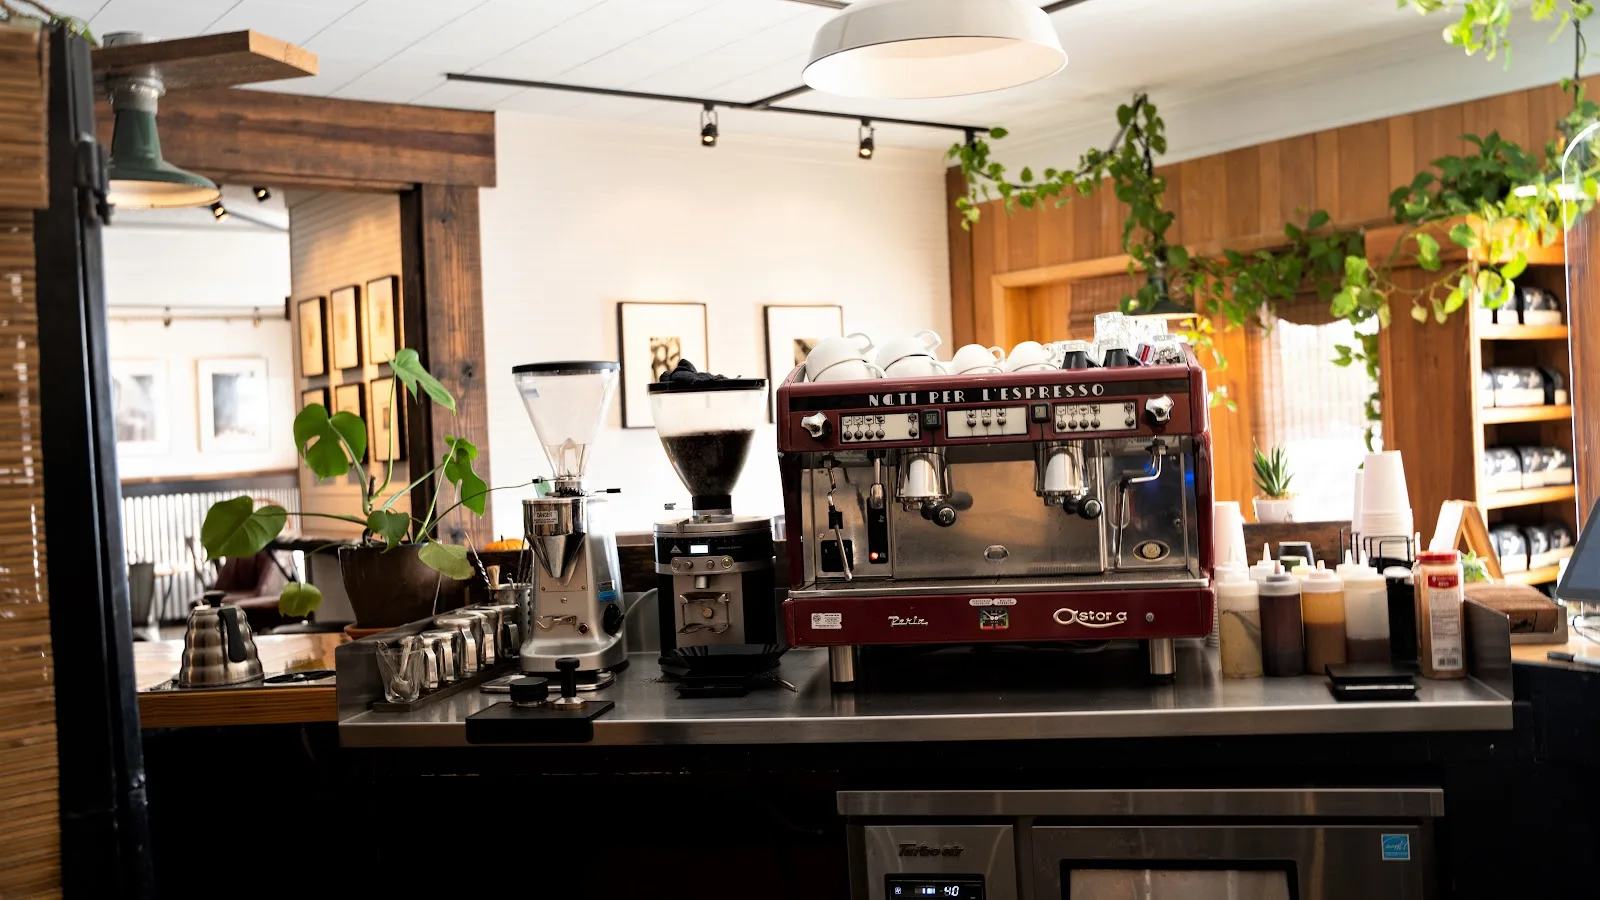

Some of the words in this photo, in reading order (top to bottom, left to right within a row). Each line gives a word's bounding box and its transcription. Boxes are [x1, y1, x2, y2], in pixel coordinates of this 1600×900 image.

[929, 390, 965, 404] PER
[983, 383, 1104, 401] L'ESPRESSO
[899, 840, 940, 856] Turbo
[942, 843, 964, 856] air
